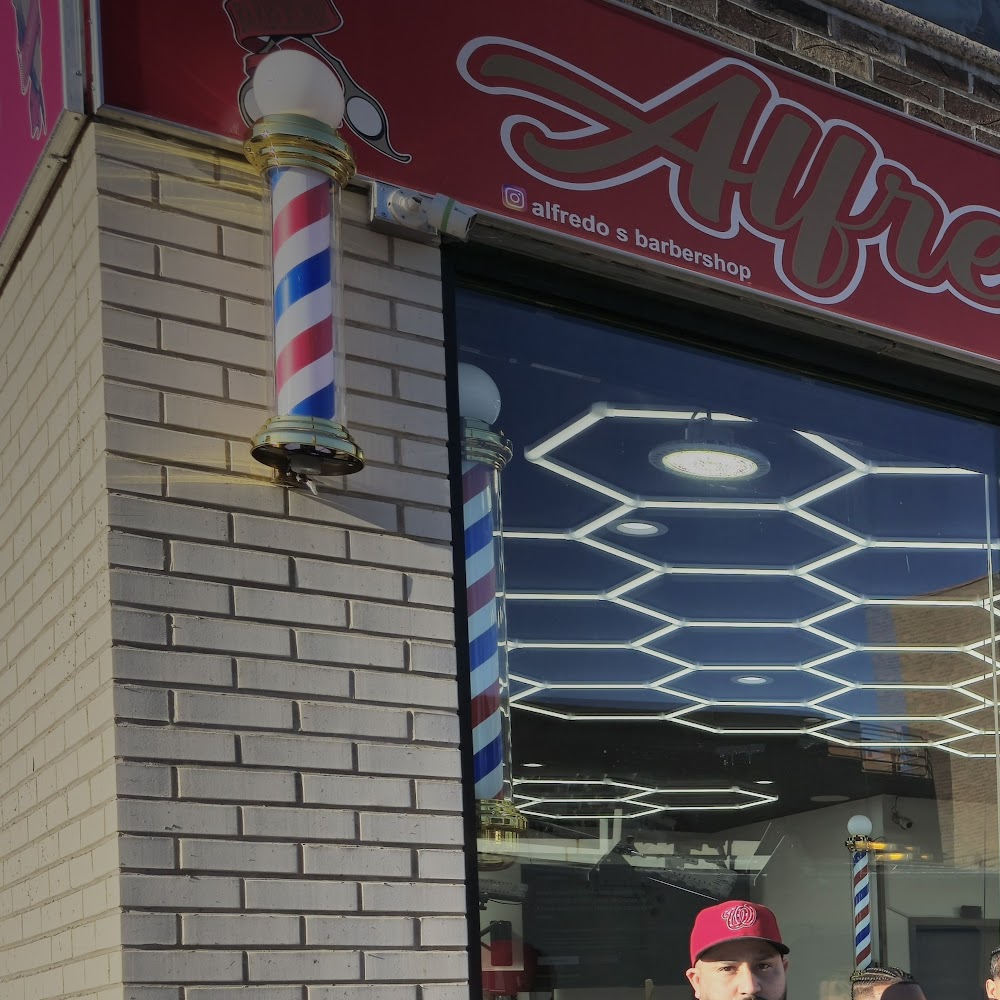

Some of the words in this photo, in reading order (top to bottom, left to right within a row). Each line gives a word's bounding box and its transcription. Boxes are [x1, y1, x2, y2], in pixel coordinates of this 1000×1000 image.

[531, 201, 610, 237] alfredo
[616, 227, 629, 242] s
[635, 228, 752, 282] barbershop
